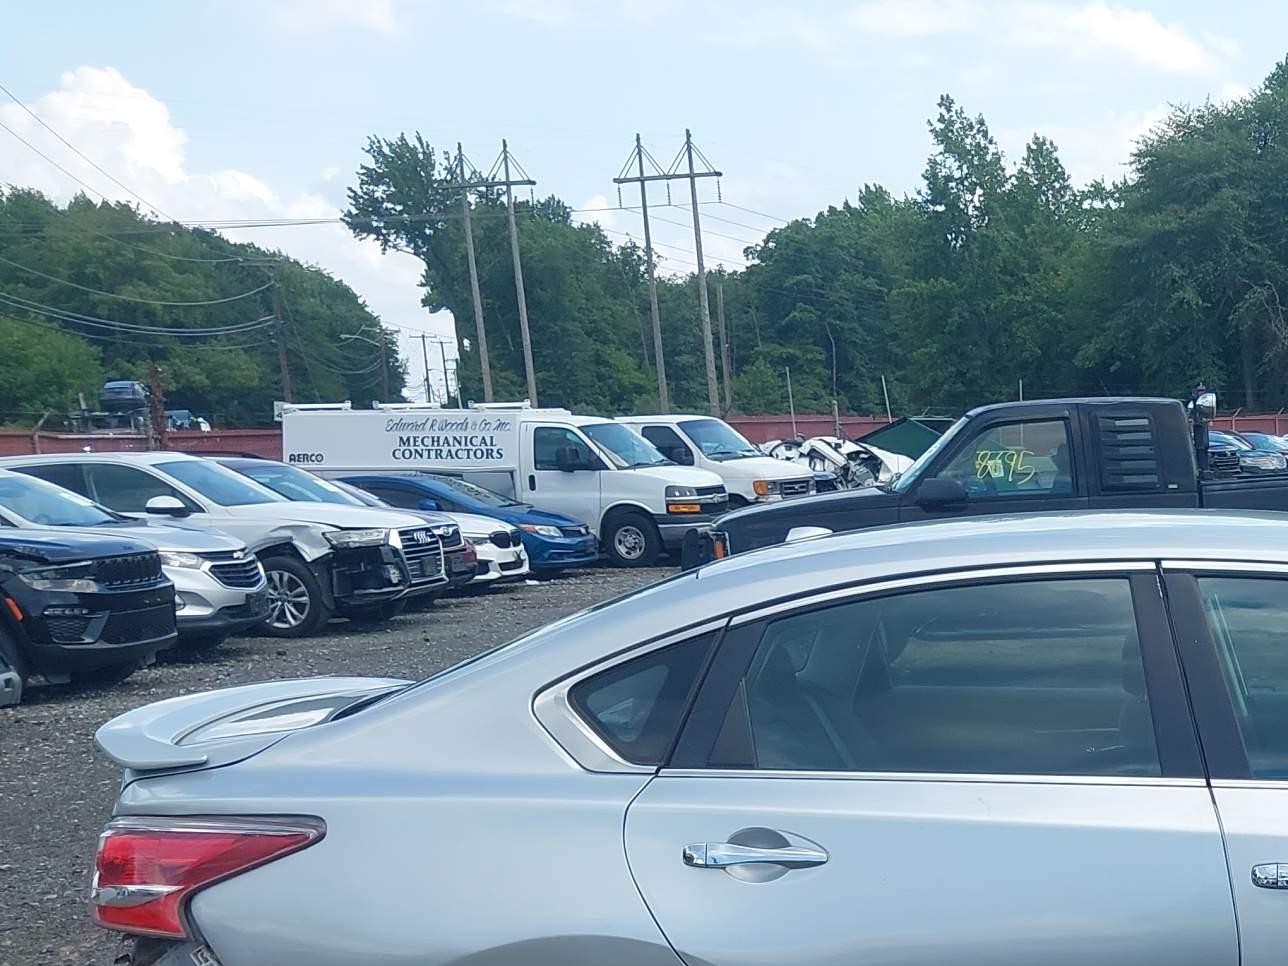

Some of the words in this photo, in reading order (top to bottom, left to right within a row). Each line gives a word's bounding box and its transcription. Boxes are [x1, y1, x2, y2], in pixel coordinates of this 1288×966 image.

[438, 417, 469, 431] Woods
[398, 435, 497, 447] MECHANICAL
[288, 453, 324, 463] AERCO
[392, 448, 504, 460] CONTRACTORS
